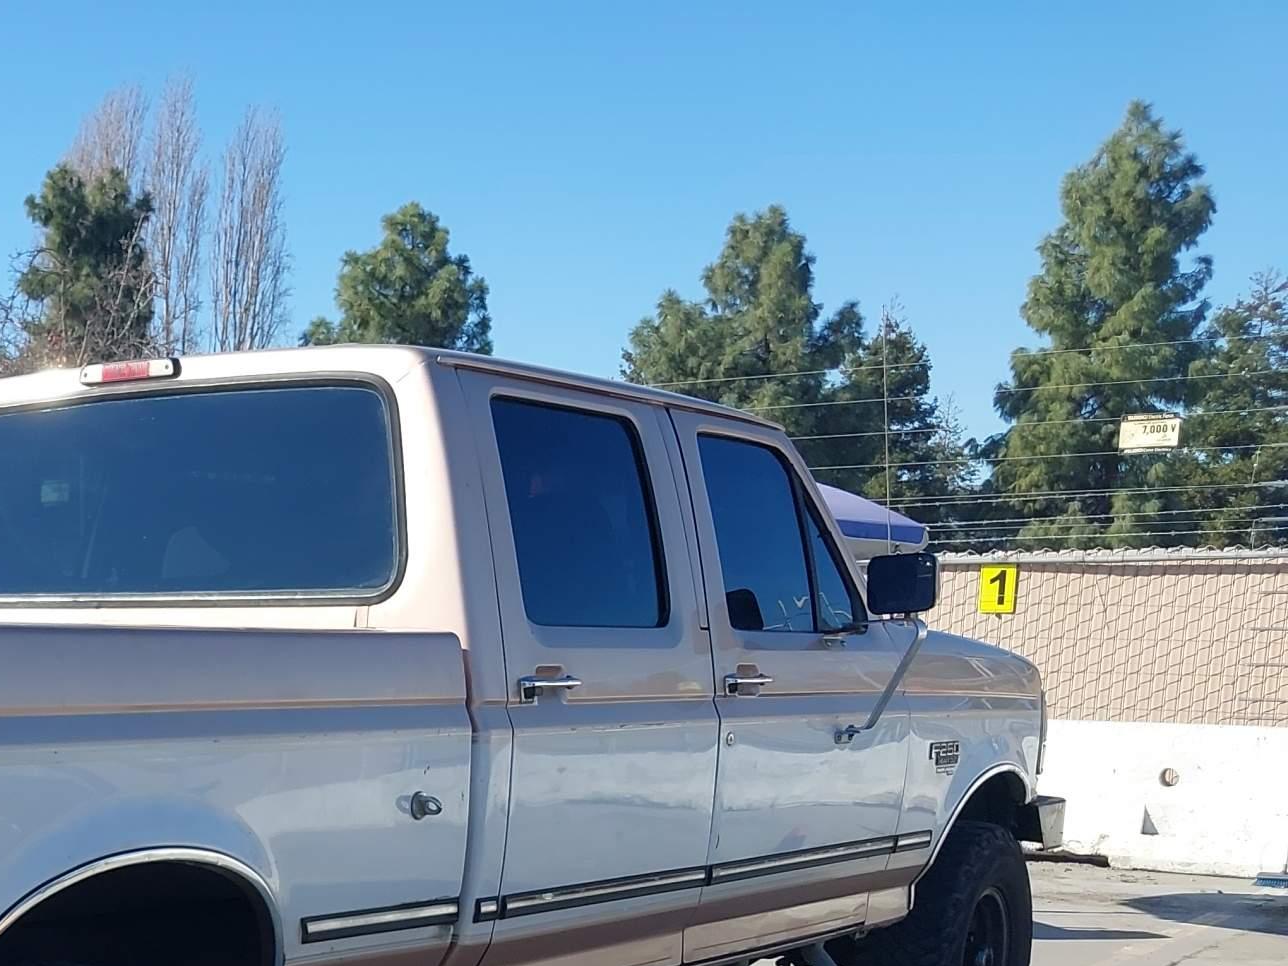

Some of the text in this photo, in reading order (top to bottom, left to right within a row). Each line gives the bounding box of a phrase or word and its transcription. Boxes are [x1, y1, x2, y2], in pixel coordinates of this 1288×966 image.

[1142, 423, 1177, 435] 7,000 V
[989, 569, 1007, 606] 1
